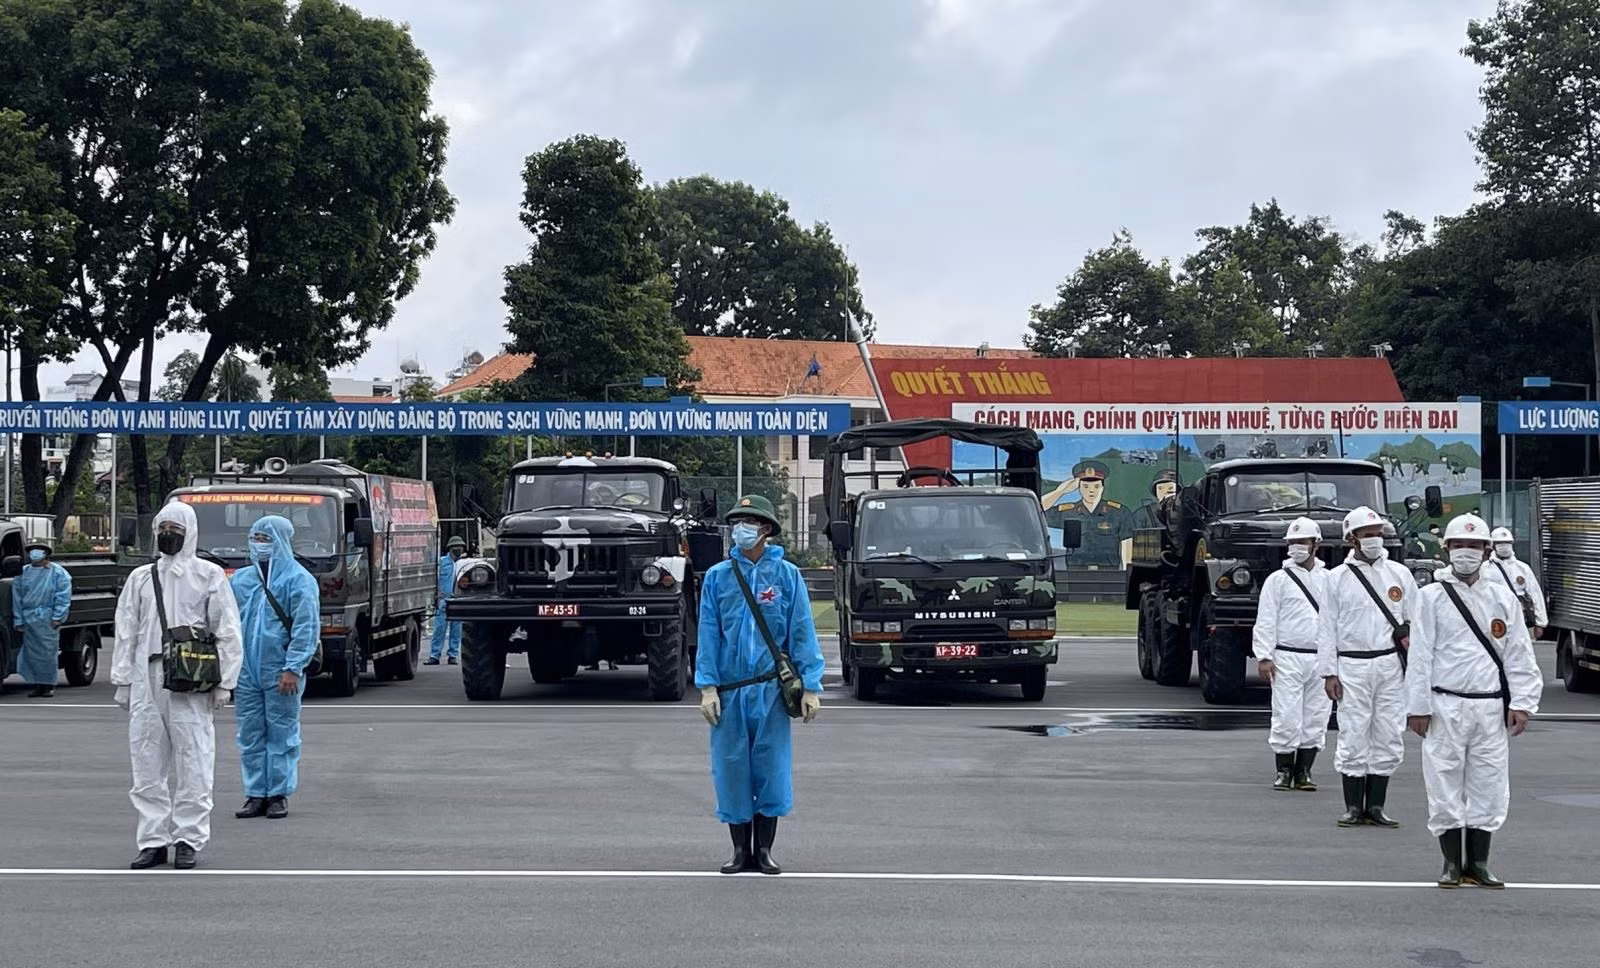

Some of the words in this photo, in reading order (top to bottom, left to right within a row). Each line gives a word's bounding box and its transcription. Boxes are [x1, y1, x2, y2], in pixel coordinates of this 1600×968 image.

[890, 366, 966, 398] QUYẾT
[968, 362, 1052, 395] THẮNG
[44, 405, 89, 429] THỐNG
[91, 407, 119, 429] ĐƠN
[121, 408, 135, 431] VỊ
[138, 409, 164, 429] ANH
[170, 407, 206, 429] HÙNG
[209, 409, 246, 432] LLVT,
[249, 406, 291, 431] QUYẾT
[295, 407, 324, 429] TÂM
[328, 407, 355, 429] XÂY
[358, 408, 395, 432] DỰNG
[398, 406, 434, 429] ĐẢNG
[438, 408, 457, 432] BỘ
[459, 410, 504, 430] TRONG
[507, 410, 540, 433] SẠCH
[545, 408, 581, 431] VỮNG
[659, 411, 673, 433] VỊ
[676, 408, 713, 431] VỮNG
[715, 411, 753, 433] MẠNH
[756, 408, 792, 431] TOÀN
[796, 408, 828, 433] DIỆN
[974, 406, 1021, 428] CÁCH
[1026, 410, 1079, 433] MẠNG,
[1084, 406, 1137, 430] CHÍNH
[1182, 410, 1221, 430] TINH
[1227, 406, 1275, 433] NHUỆ,
[1278, 405, 1325, 430] TỪNG
[1331, 405, 1378, 430] BƯỚC
[1384, 406, 1422, 433] HIỆN
[1428, 410, 1458, 433] ĐẠI
[1519, 406, 1546, 432] LỰC
[1551, 407, 1599, 432] LƯỢNG
[914, 611, 997, 620] MITSUBISHI
